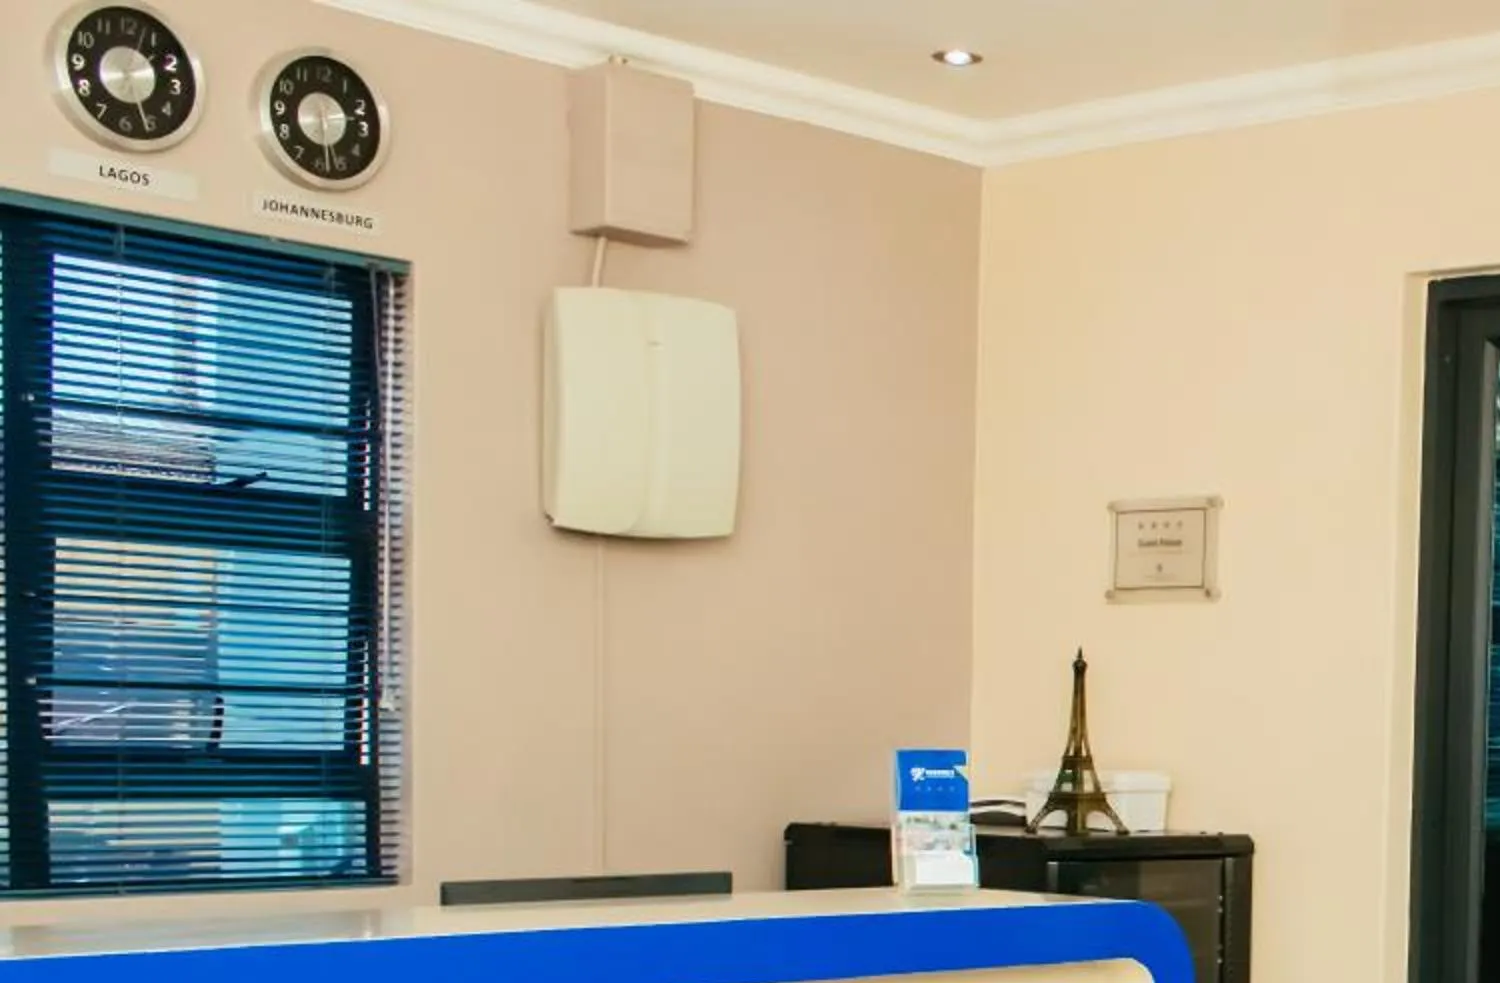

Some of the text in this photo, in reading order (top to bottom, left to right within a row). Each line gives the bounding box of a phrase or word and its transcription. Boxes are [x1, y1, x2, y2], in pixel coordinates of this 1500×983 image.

[120, 16, 138, 35] 12
[78, 31, 95, 48] 10
[71, 53, 86, 71] 9
[164, 54, 178, 72] 2
[78, 78, 91, 96] 8
[169, 78, 182, 96] 3
[96, 103, 108, 118] 7
[161, 101, 173, 117] 4
[273, 101, 286, 116] 9
[354, 99, 367, 116] 2
[118, 115, 133, 133] 6
[279, 122, 290, 140] 8
[357, 121, 369, 138] 3
[99, 164, 151, 187] LAGOS
[262, 198, 375, 230] JOHANNESBURG
